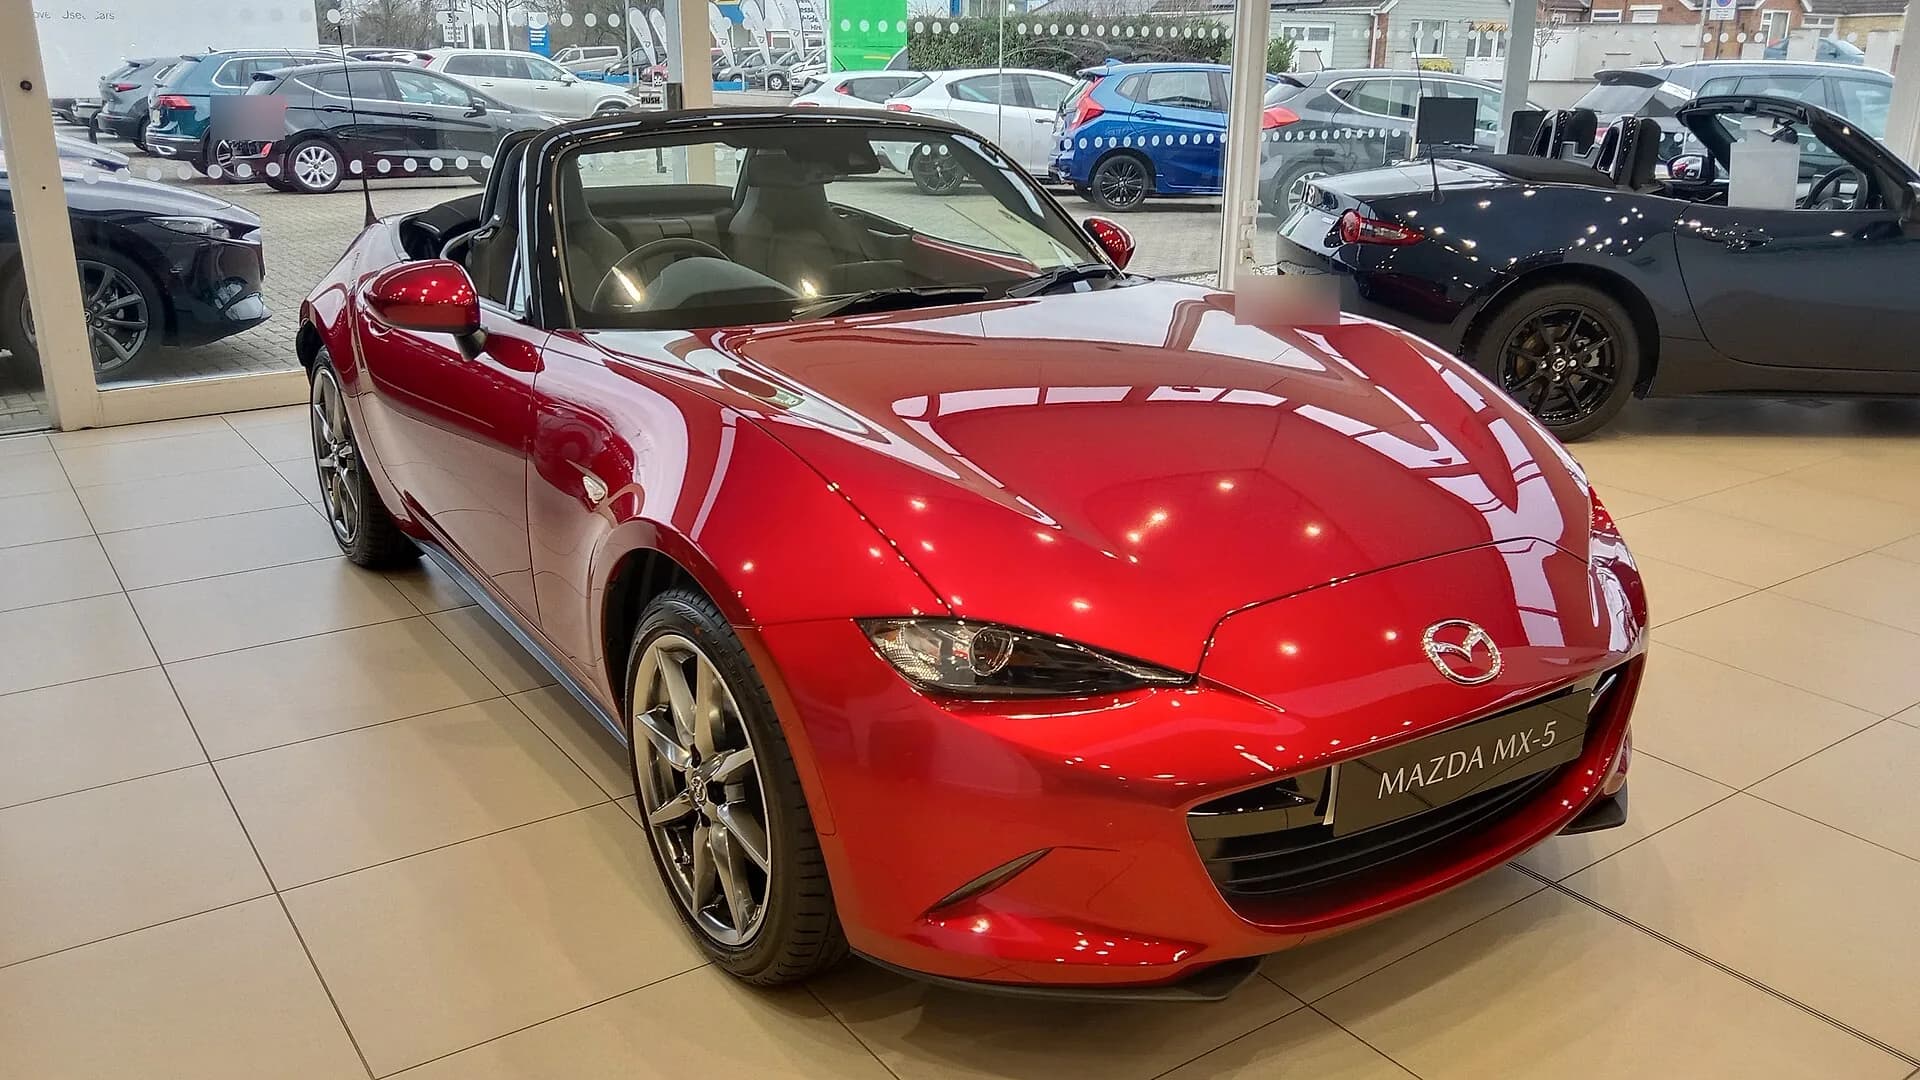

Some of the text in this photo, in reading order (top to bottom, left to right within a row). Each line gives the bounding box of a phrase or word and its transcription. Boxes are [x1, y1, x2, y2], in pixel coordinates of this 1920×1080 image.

[62, 9, 87, 19] Use
[641, 96, 660, 104] PUSH
[1378, 720, 1557, 799] MAZDA MX-5
